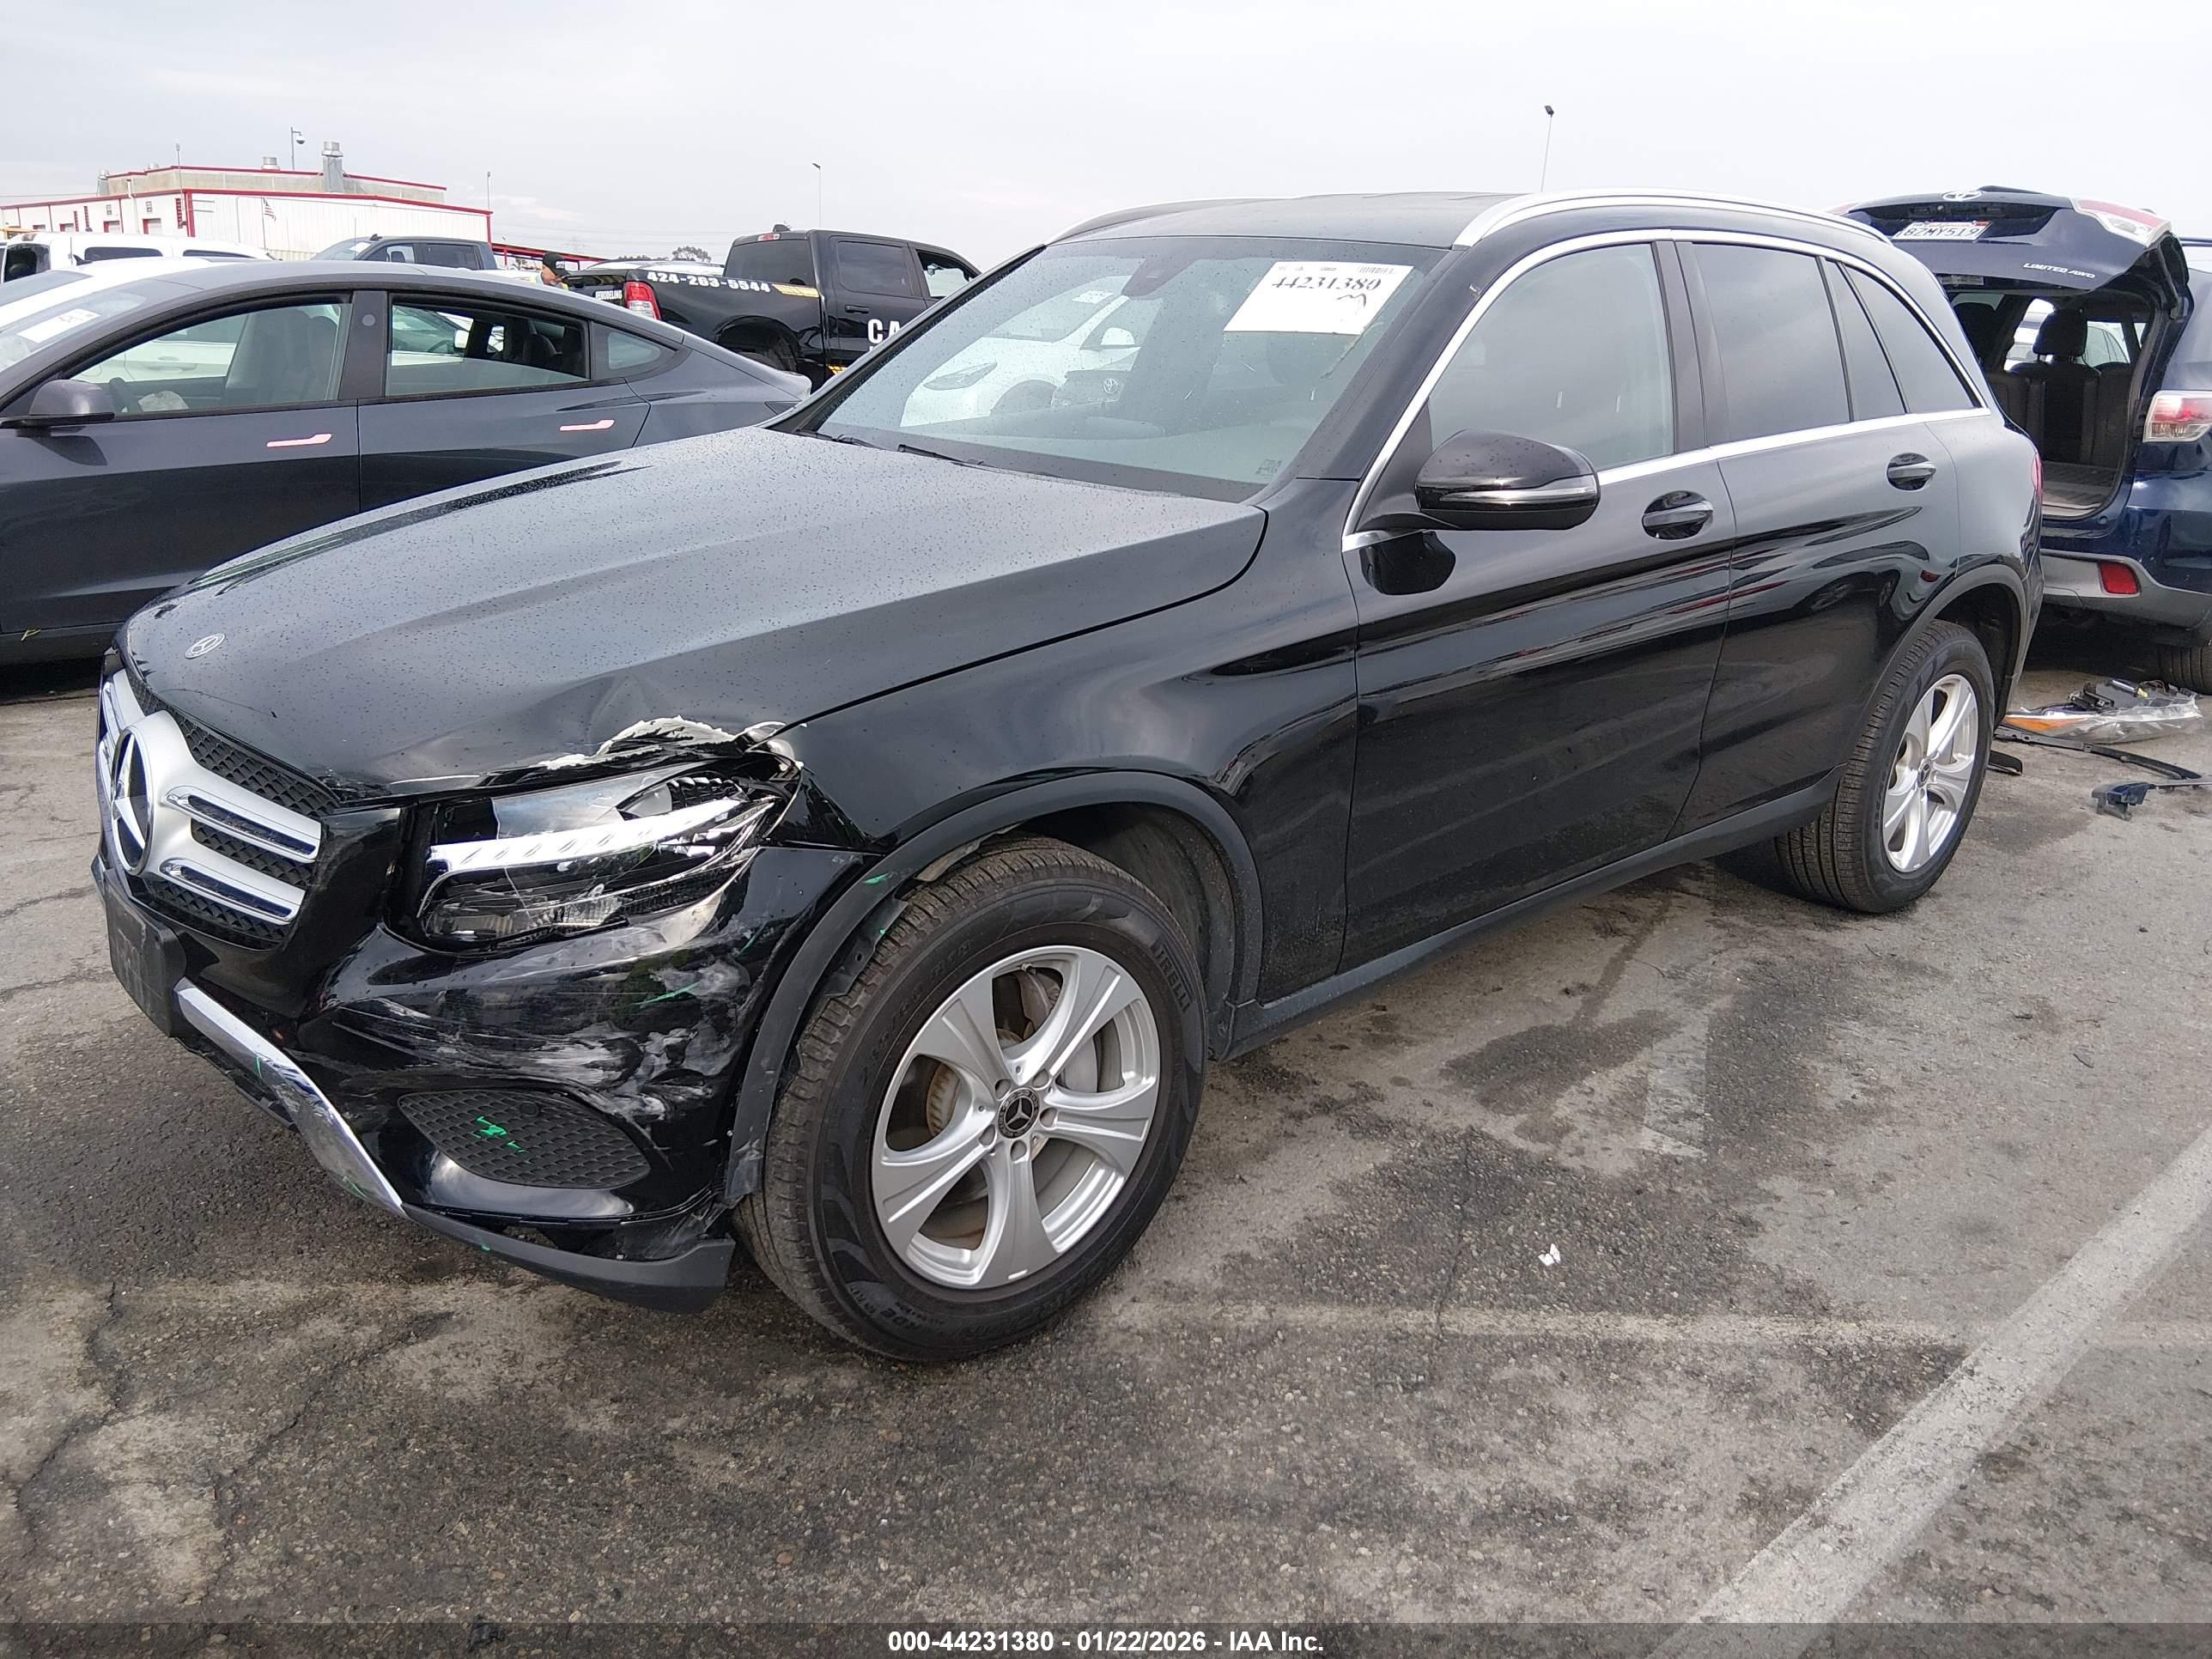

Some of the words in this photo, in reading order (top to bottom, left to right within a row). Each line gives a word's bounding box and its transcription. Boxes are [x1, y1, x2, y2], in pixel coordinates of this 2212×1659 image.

[1904, 228, 1980, 237] 8ZMY519
[2024, 263, 2068, 273] LIMITED
[2068, 270, 2095, 278] AWD
[647, 271, 771, 292] 424-263-5544
[1272, 276, 1382, 290] 44231380
